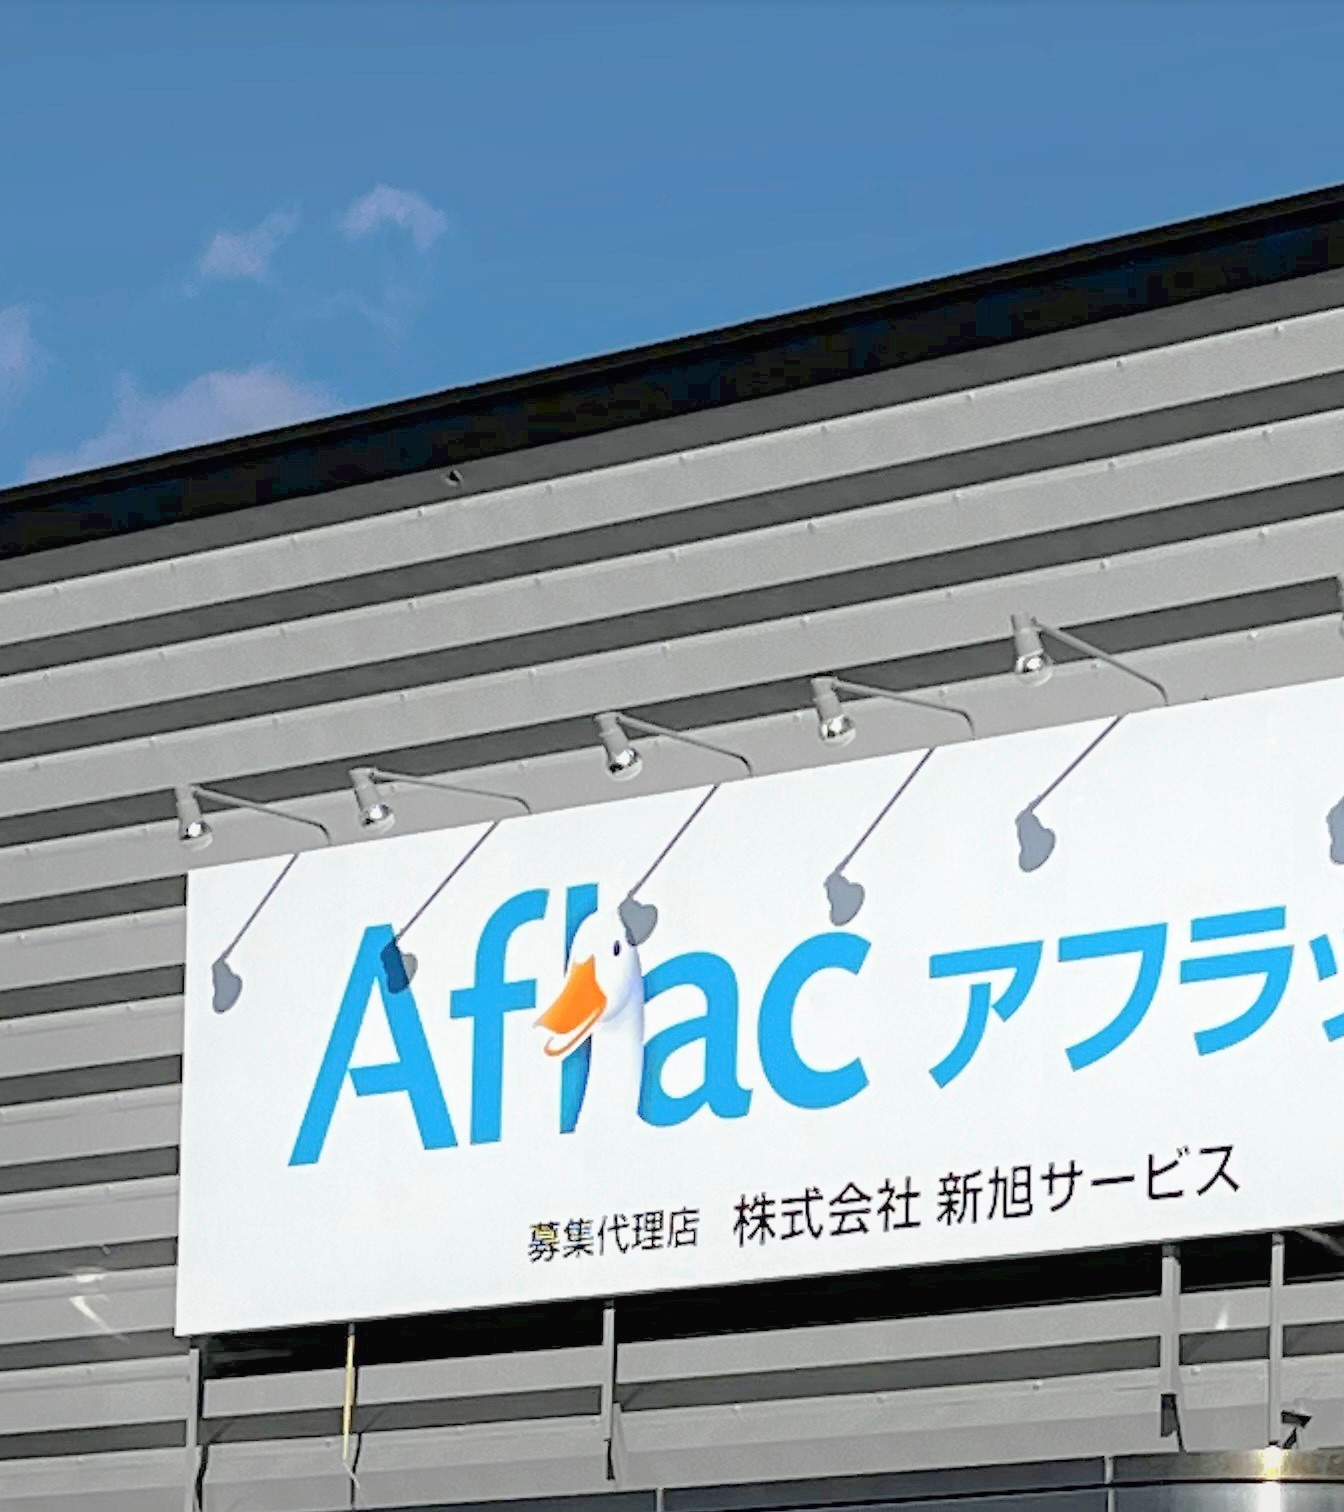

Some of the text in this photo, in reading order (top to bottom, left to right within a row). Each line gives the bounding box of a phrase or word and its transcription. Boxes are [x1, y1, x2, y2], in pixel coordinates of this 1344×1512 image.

[287, 882, 871, 1166] Aflac
[527, 1144, 1241, 1264] 募集代理店 株式会社 新旭サービス
